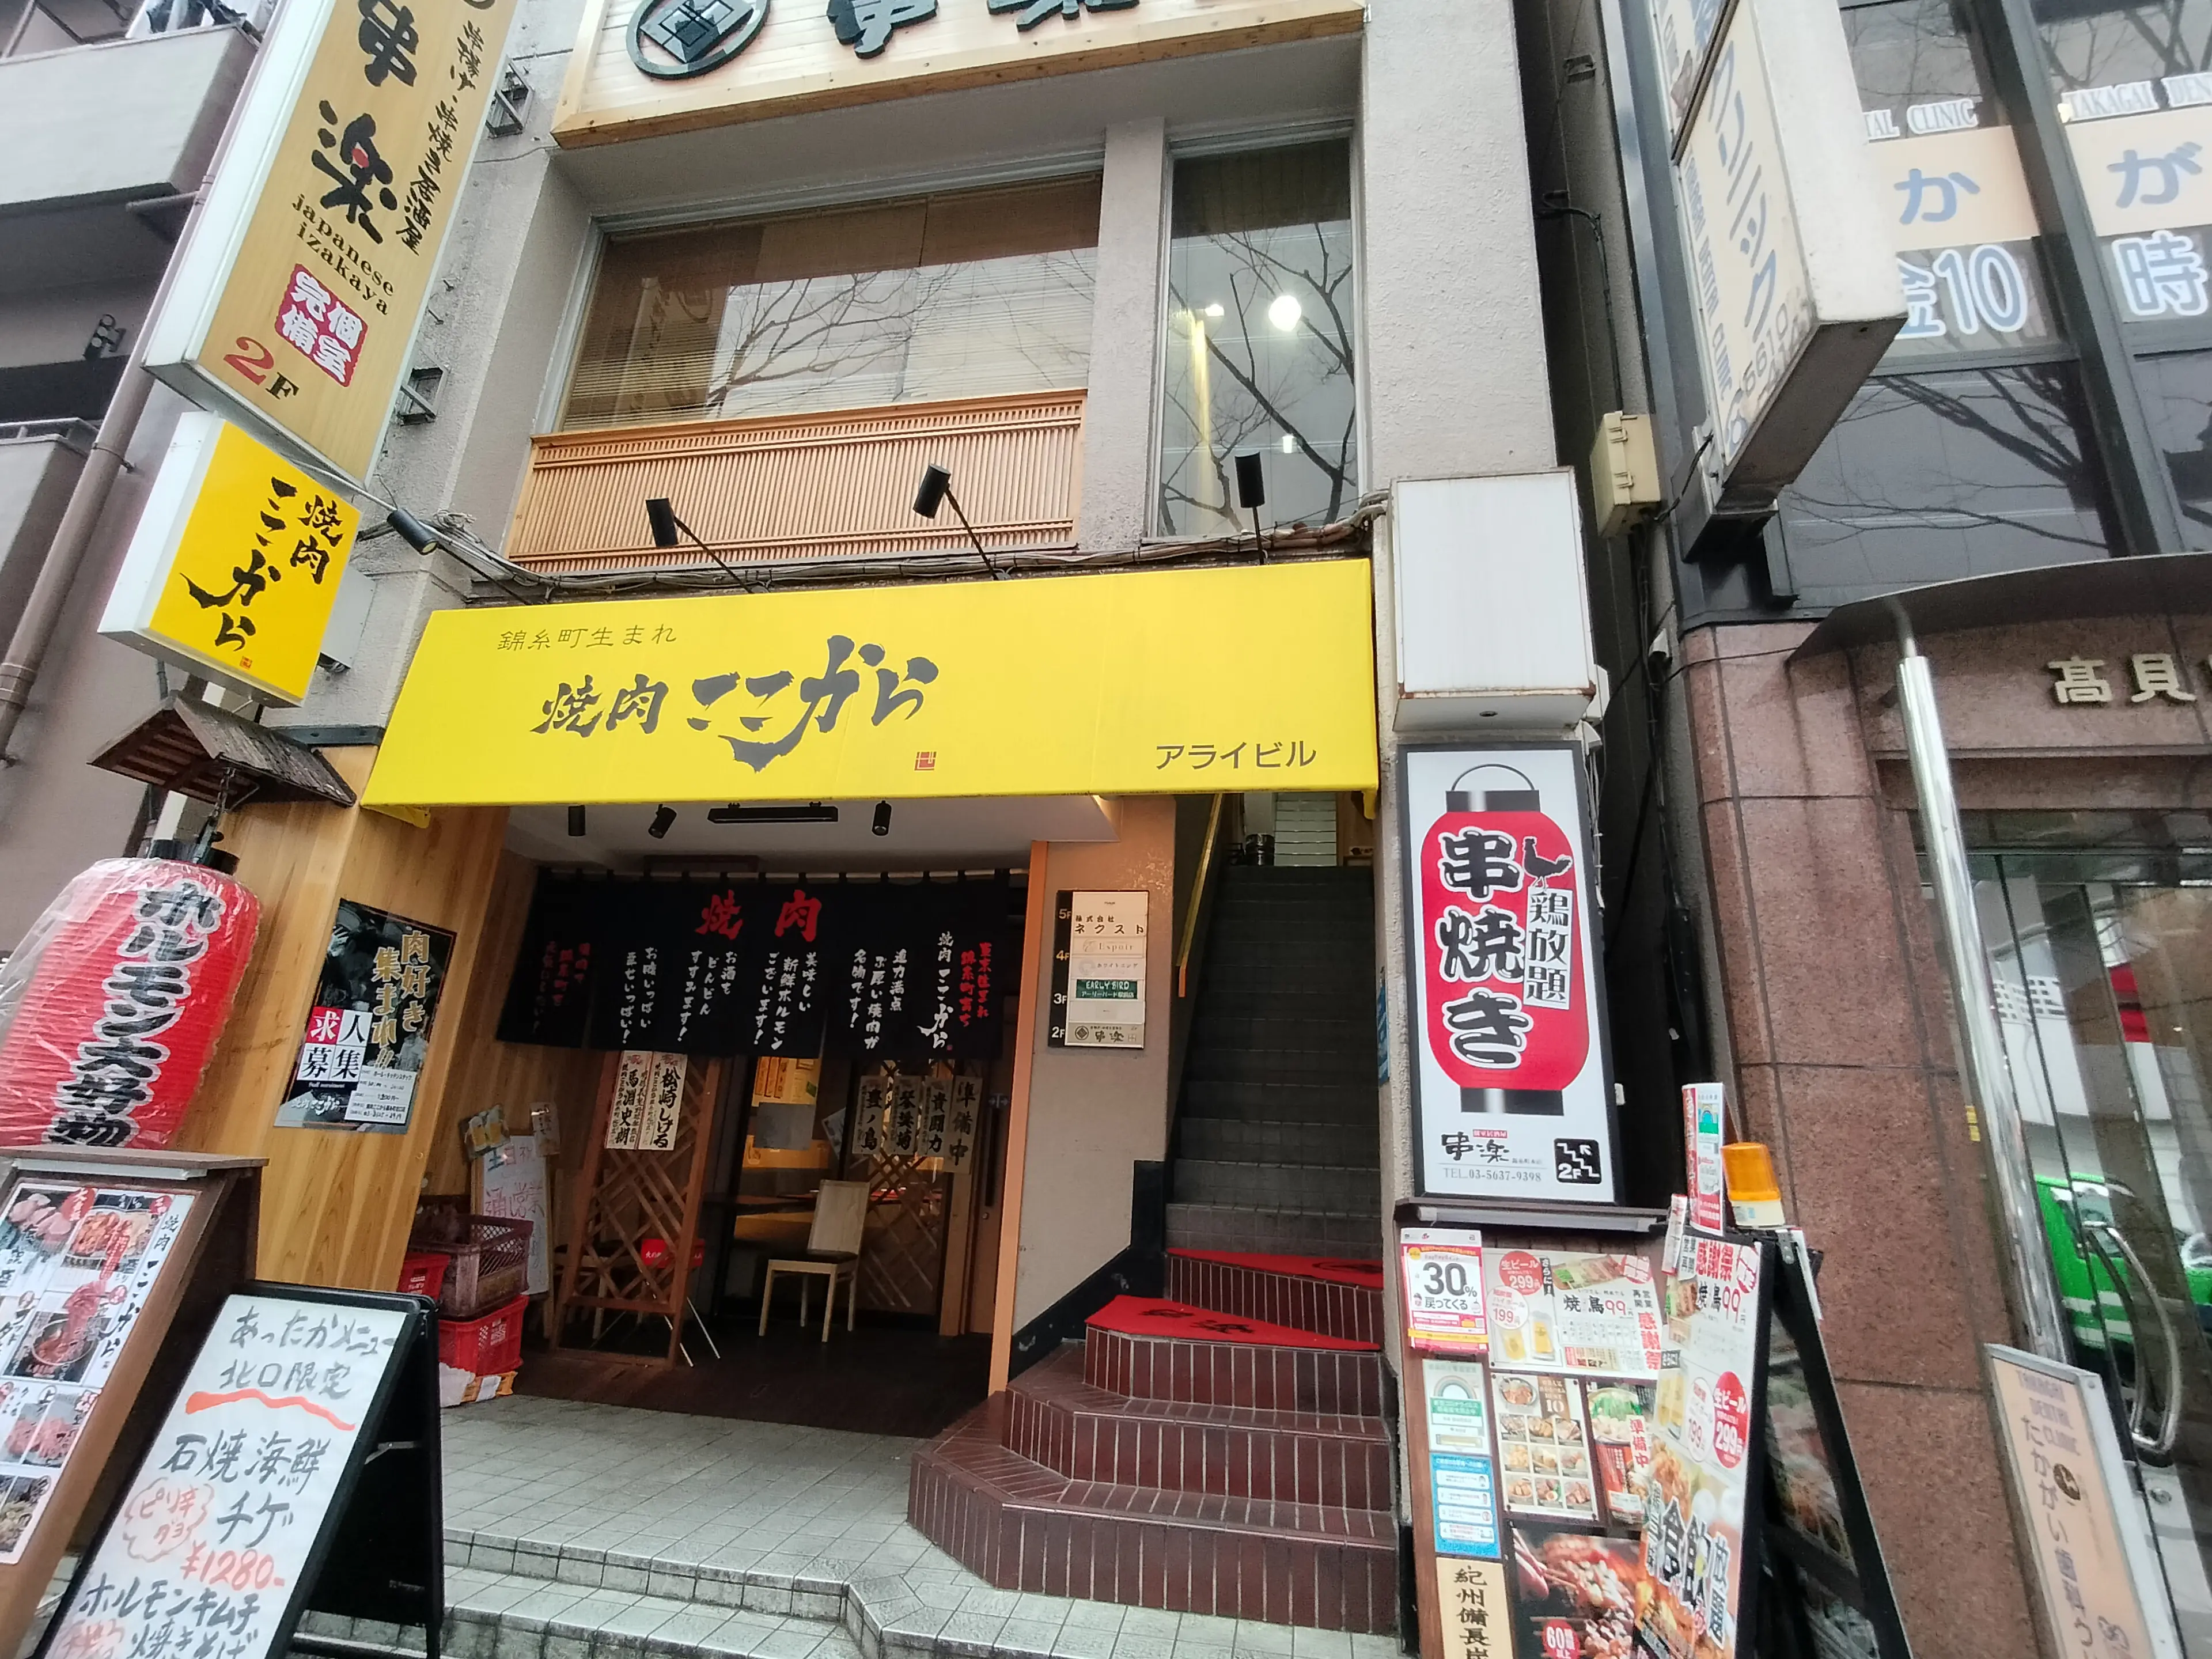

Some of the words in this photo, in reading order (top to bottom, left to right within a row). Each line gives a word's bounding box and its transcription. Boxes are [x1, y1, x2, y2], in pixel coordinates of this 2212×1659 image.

[1907, 99, 1978, 133] CLINIC
[2062, 81, 2157, 119] TAKAGAI
[1893, 168, 1980, 225] か
[2107, 141, 2203, 208] が
[292, 194, 395, 296] japanese
[297, 221, 390, 315] izakaya
[2112, 231, 2208, 315] 時
[224, 336, 300, 403] 2F
[179, 476, 298, 652] ここから
[289, 494, 344, 584] 焼肉
[497, 622, 677, 652] 錦糸町生まれ
[1155, 740, 1317, 770] アライビル
[695, 889, 822, 942] 焼肉
[1059, 908, 1072, 920] 5F
[1074, 923, 1144, 935] ネクスト
[1056, 949, 1070, 961] 4F
[1438, 828, 1533, 1067] 串焼き
[1527, 891, 1570, 1002] 鶏放題
[401, 929, 431, 1033] 肉好き
[754, 951, 780, 1045] ございます！
[771, 956, 799, 1050] 新鮮ホルモン
[798, 952, 819, 1012] 美味しい
[850, 948, 868, 1028] 名物です！
[864, 956, 888, 1050] ぶ厚い焼肉が
[890, 948, 908, 1012] 迫力満点
[1053, 993, 1067, 1005] 3F
[1086, 980, 1110, 990] EARLY
[1112, 980, 1130, 990] BIRD
[1051, 1027, 1065, 1039] 2F
[653, 1066, 682, 1148] 松崎しげる
[949, 1081, 976, 1166] 準備中
[1441, 1131, 1510, 1164] 串楽
[1558, 1163, 1583, 1180] 2F
[1501, 1259, 1540, 1270] 生ビール
[229, 1305, 396, 1358] あったかメニュー
[1424, 1296, 1468, 1310] 戻ってくる
[219, 1361, 354, 1400] 北口限定
[1546, 1399, 1565, 1412] 10
[159, 1429, 332, 1495] 石焼海鮮
[217, 1490, 294, 1549] チゲ
[78, 1572, 261, 1636] ホルモンキムチ
